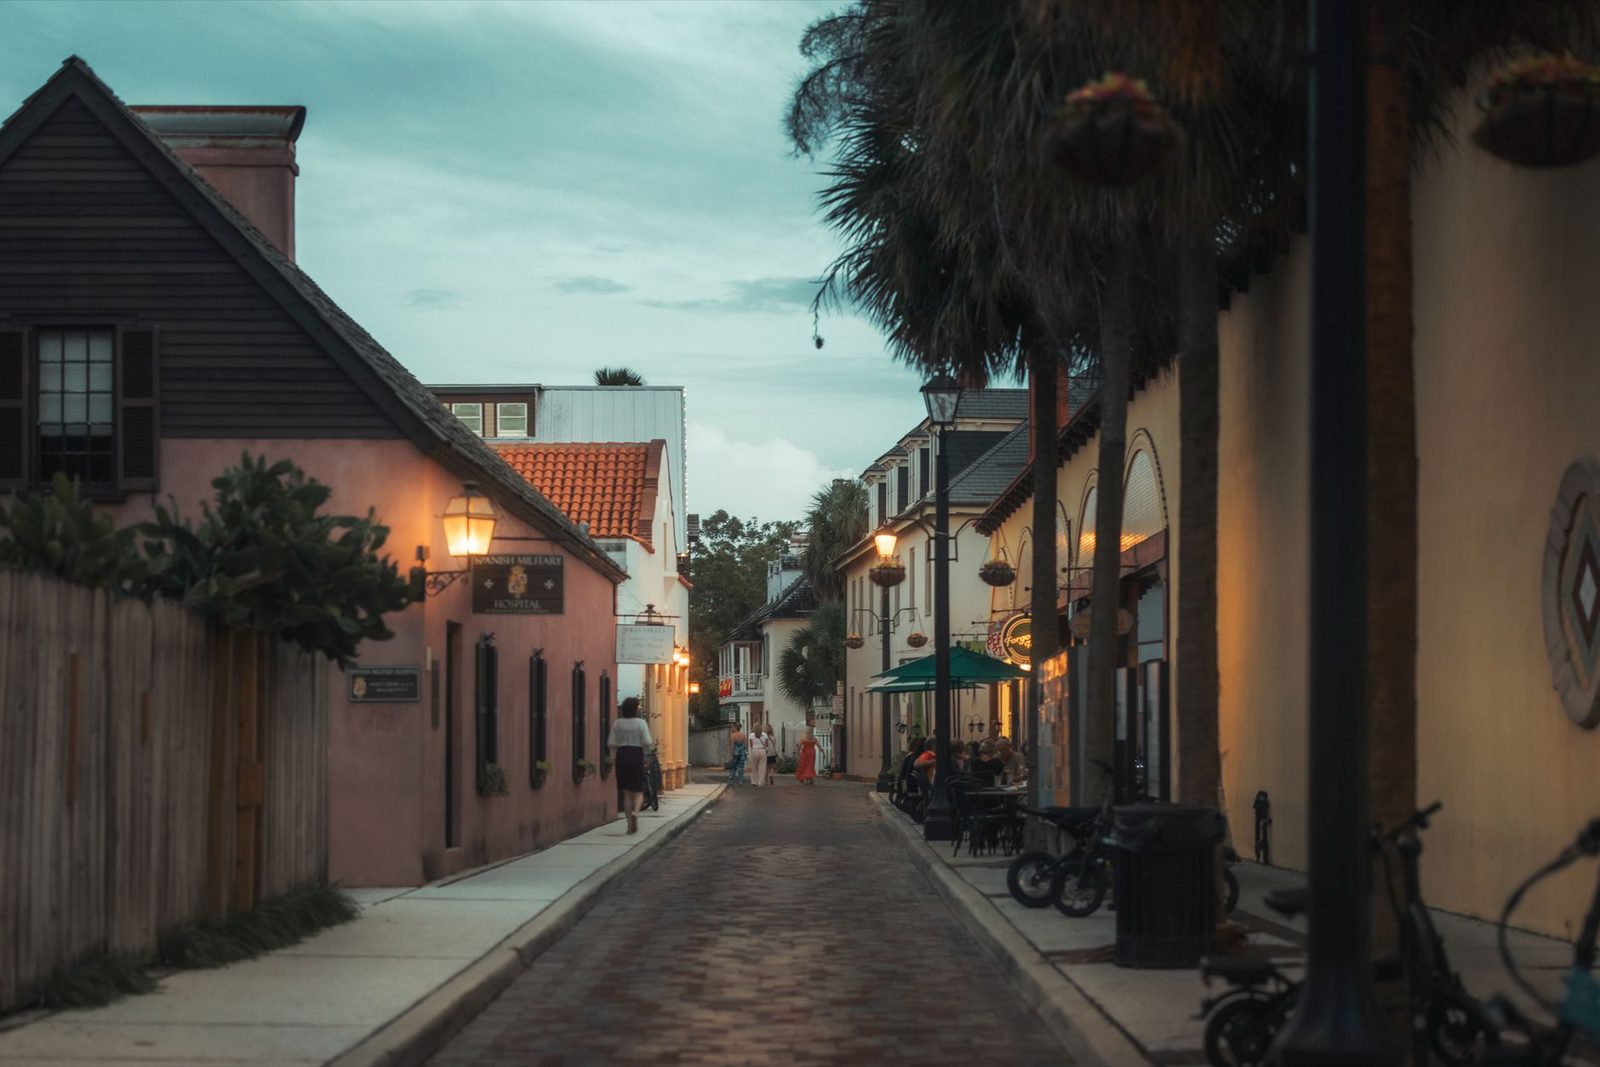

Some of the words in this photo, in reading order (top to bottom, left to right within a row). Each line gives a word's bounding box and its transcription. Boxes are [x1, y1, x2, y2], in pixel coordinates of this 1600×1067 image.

[517, 556, 561, 565] MILITARY
[494, 600, 540, 608] HOSPITAL
[1004, 634, 1031, 648] Forgo
